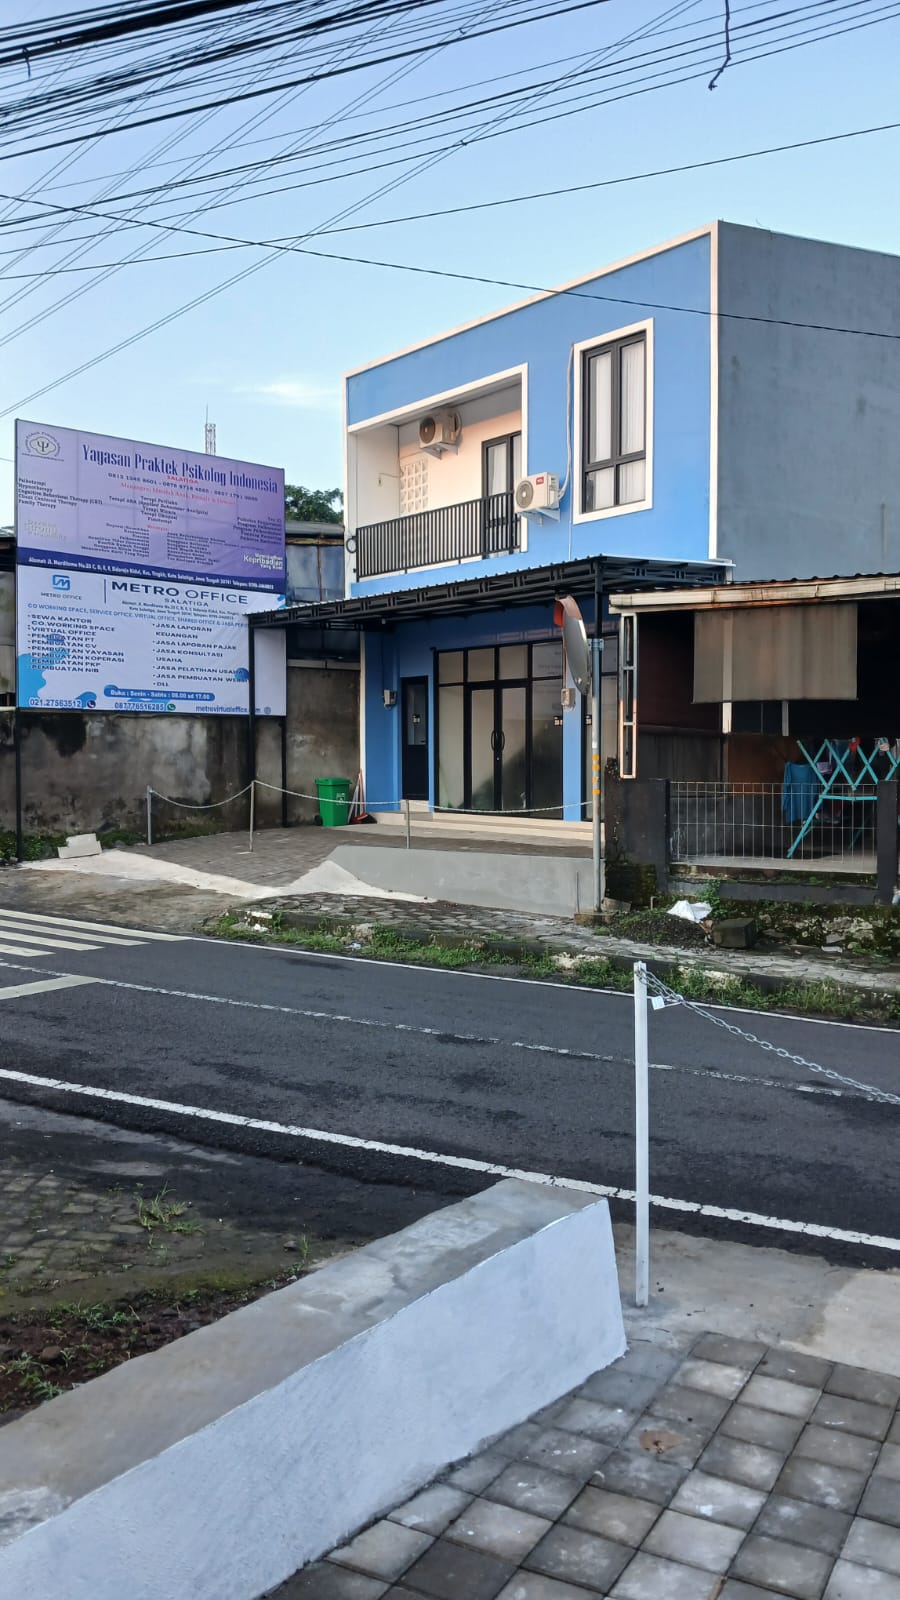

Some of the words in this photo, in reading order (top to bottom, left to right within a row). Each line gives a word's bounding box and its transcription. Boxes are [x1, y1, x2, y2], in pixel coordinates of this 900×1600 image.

[83, 444, 131, 468] Yayasan
[135, 453, 178, 476] Praktek
[182, 462, 227, 487] Psikolog
[230, 470, 278, 494] Indonesia
[167, 475, 199, 484] SALATIGA
[111, 581, 180, 597] METRO
[185, 589, 248, 605] OFFICE
[164, 598, 209, 607] SALATIGA
[39, 604, 67, 612] WORKING
[89, 608, 112, 616] SERVICE
[57, 616, 92, 624] KANTOR
[31, 626, 67, 634] VIRTUAL
[177, 624, 212, 632] LAPORAN
[32, 633, 83, 642] PEMBUATAN
[155, 631, 198, 639] KEUANGAN
[32, 640, 83, 648] PEMBUATAN
[177, 641, 212, 649] LAPORAN
[32, 646, 83, 654] PEMBUATAN
[84, 649, 124, 657] YAYASAN
[177, 649, 223, 657] KONSULTASI
[32, 652, 83, 660] PEMBUATAN
[85, 655, 125, 663] KOPERASI
[32, 658, 83, 666] PEMBUATAN
[32, 665, 83, 673] PEMBUATAN
[177, 666, 218, 674] PELATIHAN
[177, 674, 223, 682] PEMBUATAN
